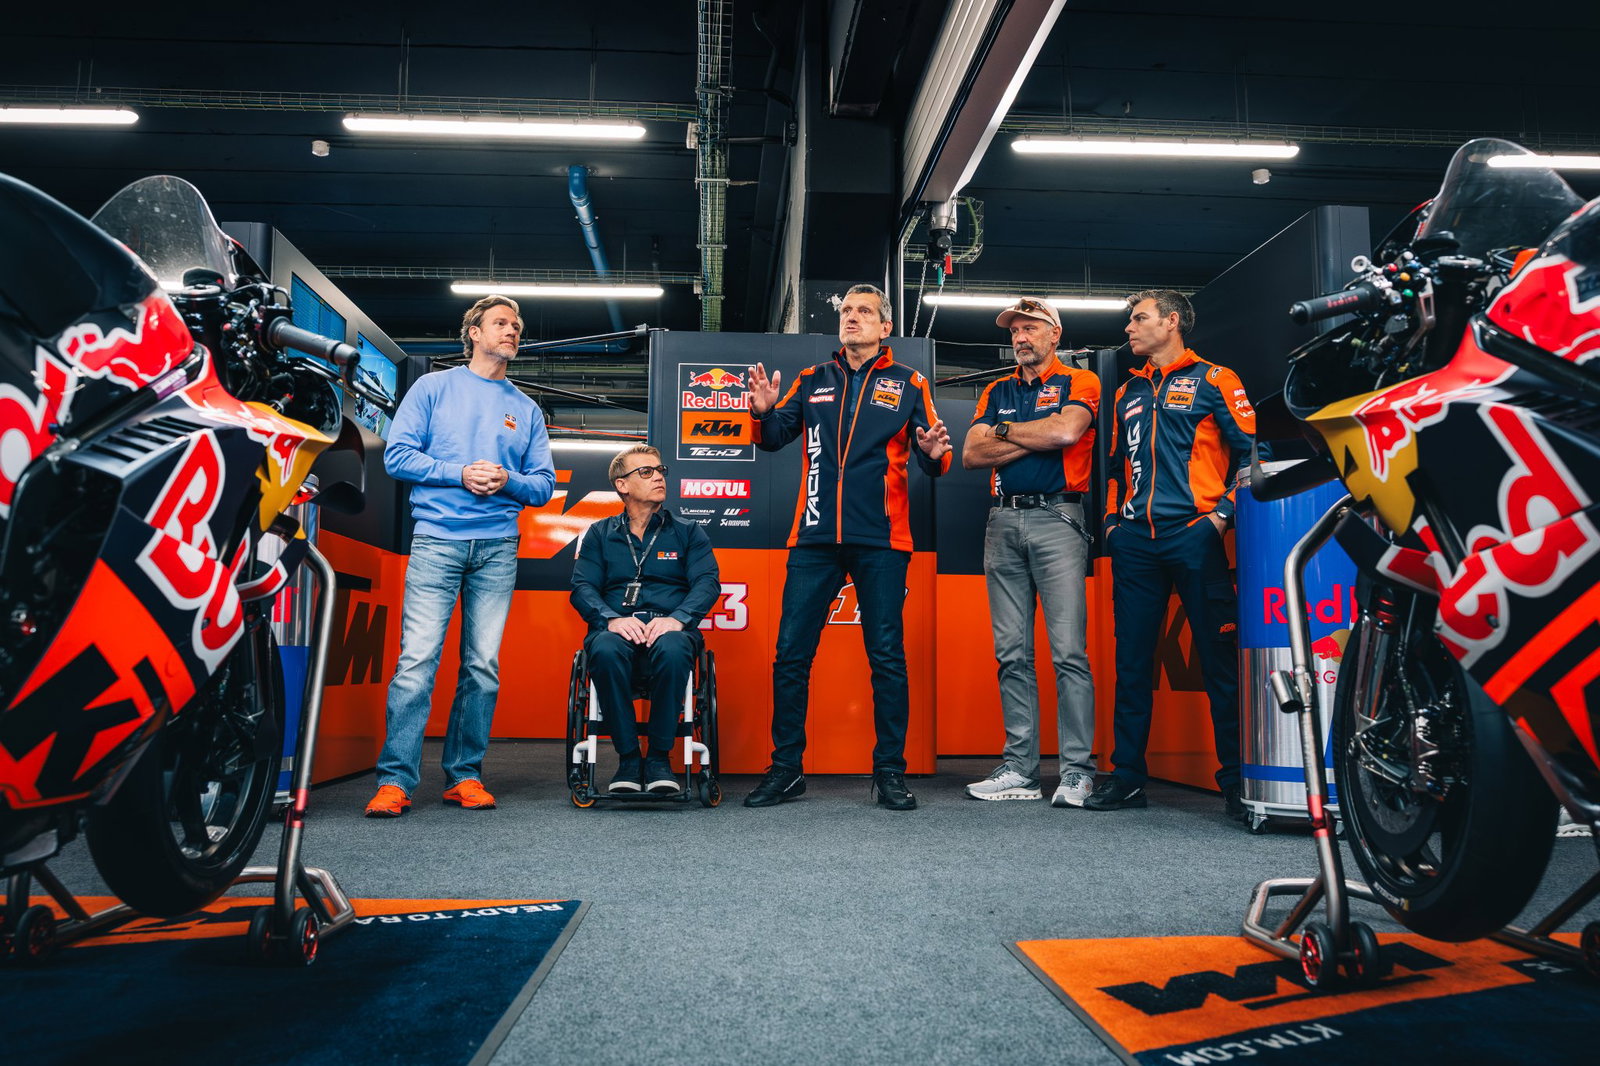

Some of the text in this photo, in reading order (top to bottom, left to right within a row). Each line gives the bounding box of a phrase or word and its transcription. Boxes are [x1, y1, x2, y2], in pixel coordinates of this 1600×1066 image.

[682, 391, 717, 409] Red
[690, 420, 742, 437] KTM
[806, 424, 822, 526] RACING
[684, 482, 747, 496] MOTUL
[697, 582, 749, 631] 3
[408, 913, 453, 922] TO
[461, 903, 565, 918] READY
[1166, 1022, 1344, 1066] KTM.COM
